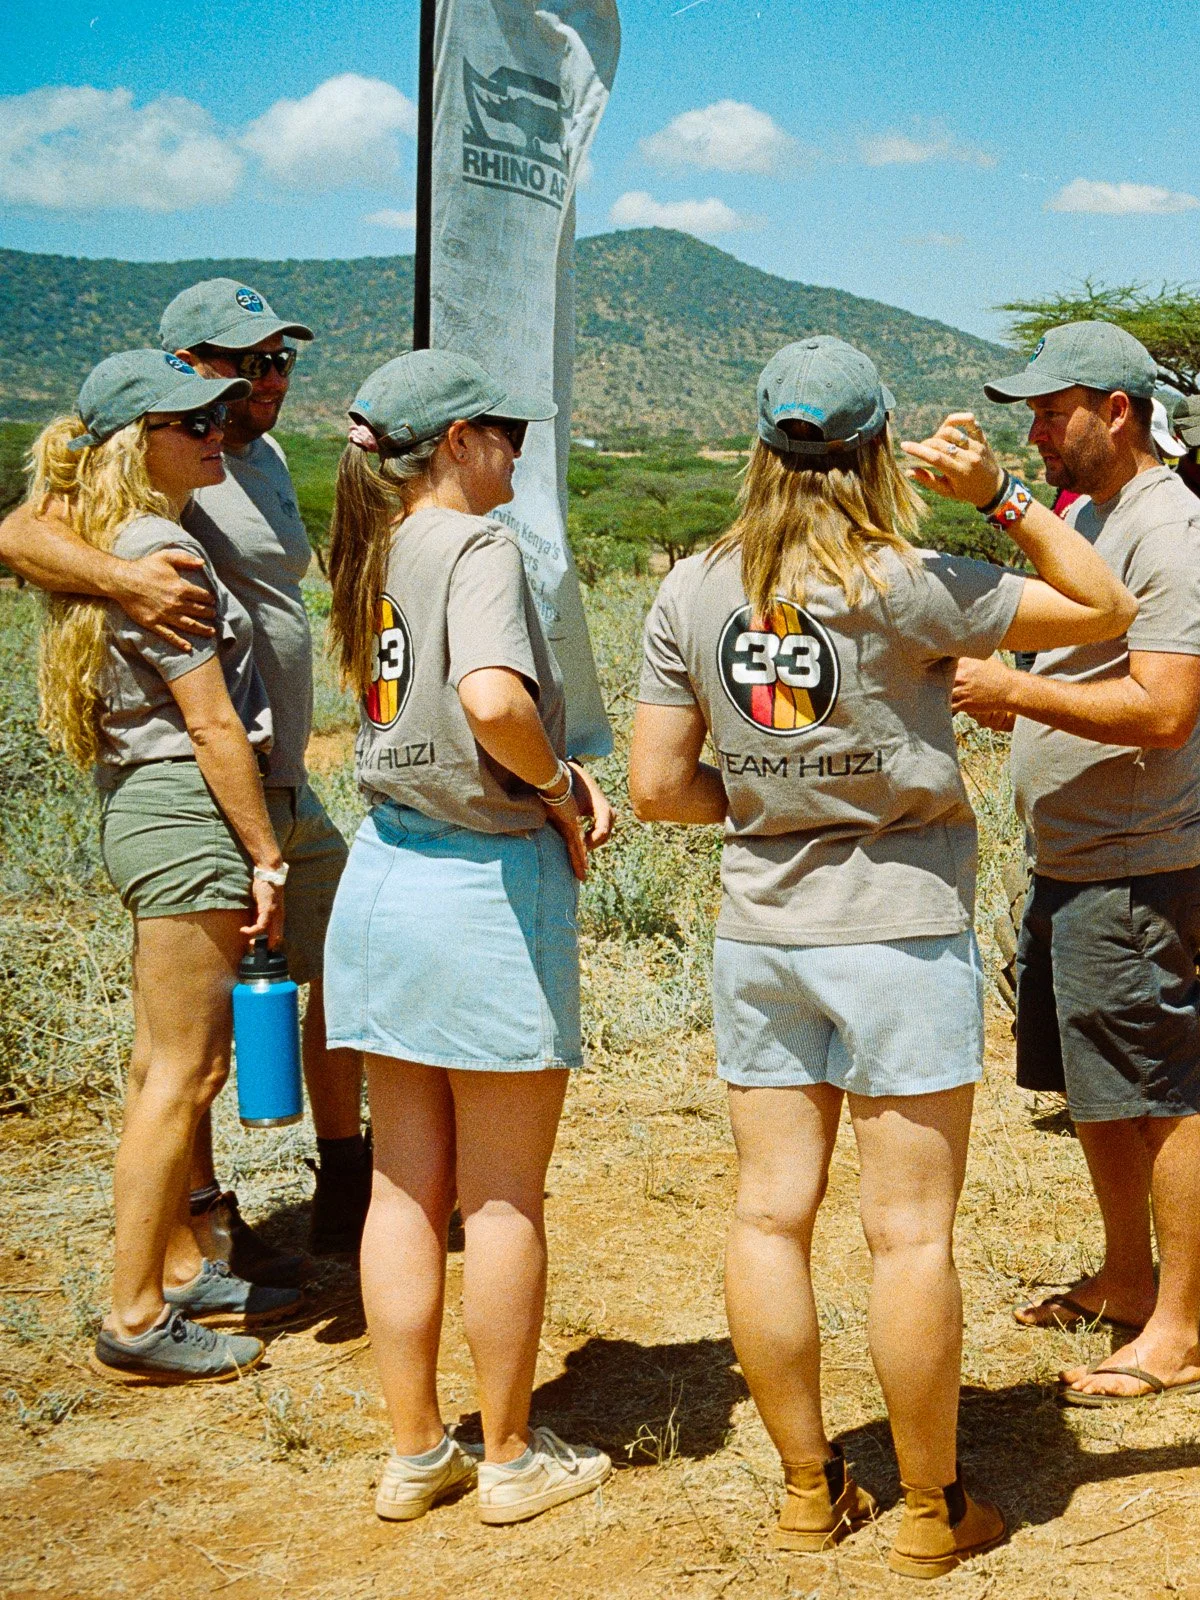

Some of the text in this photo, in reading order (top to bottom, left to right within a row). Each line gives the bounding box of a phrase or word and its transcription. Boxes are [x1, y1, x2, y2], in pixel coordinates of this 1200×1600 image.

[463, 148, 568, 201] RHINO AR
[238, 294, 260, 306] 33
[521, 523, 561, 561] Kenya's
[732, 631, 821, 689] 33
[378, 742, 436, 770] HUZI
[800, 749, 883, 778] HUZI
